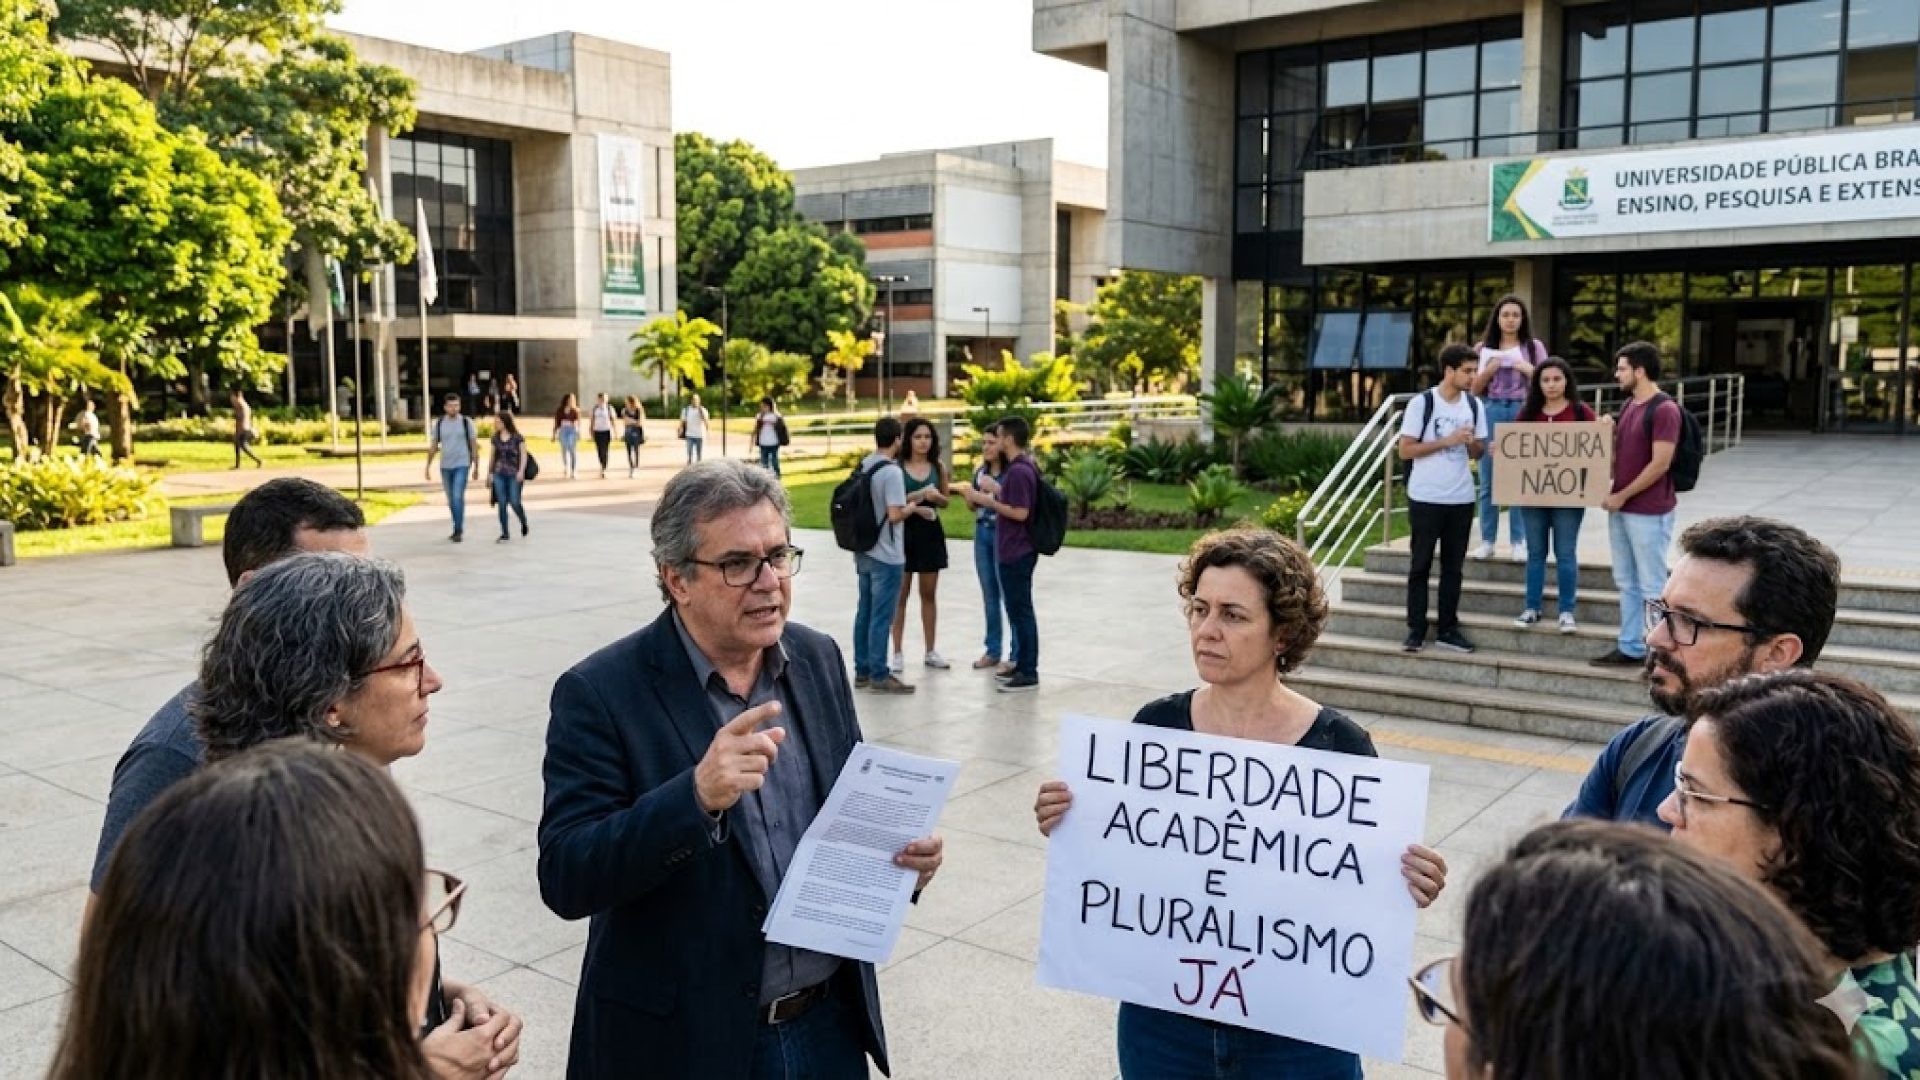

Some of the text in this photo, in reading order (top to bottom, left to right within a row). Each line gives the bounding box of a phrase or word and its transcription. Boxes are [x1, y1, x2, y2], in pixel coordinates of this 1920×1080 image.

[1615, 159, 1768, 188] UNIVERSIDADE
[1774, 153, 1868, 176] PÚBLICA
[1617, 193, 1698, 215] ENSINO,
[1705, 186, 1812, 210] PESQUISA
[1819, 184, 1831, 203] E
[1500, 431, 1606, 460] CENSURA
[1521, 462, 1588, 499] NÃO!
[1086, 733, 1382, 828] LIBERDADE
[1102, 801, 1364, 885] ACADÊMICA
[1205, 869, 1227, 897] E
[1080, 879, 1374, 978] PLURALISMO
[1173, 958, 1256, 1017] JÁ
